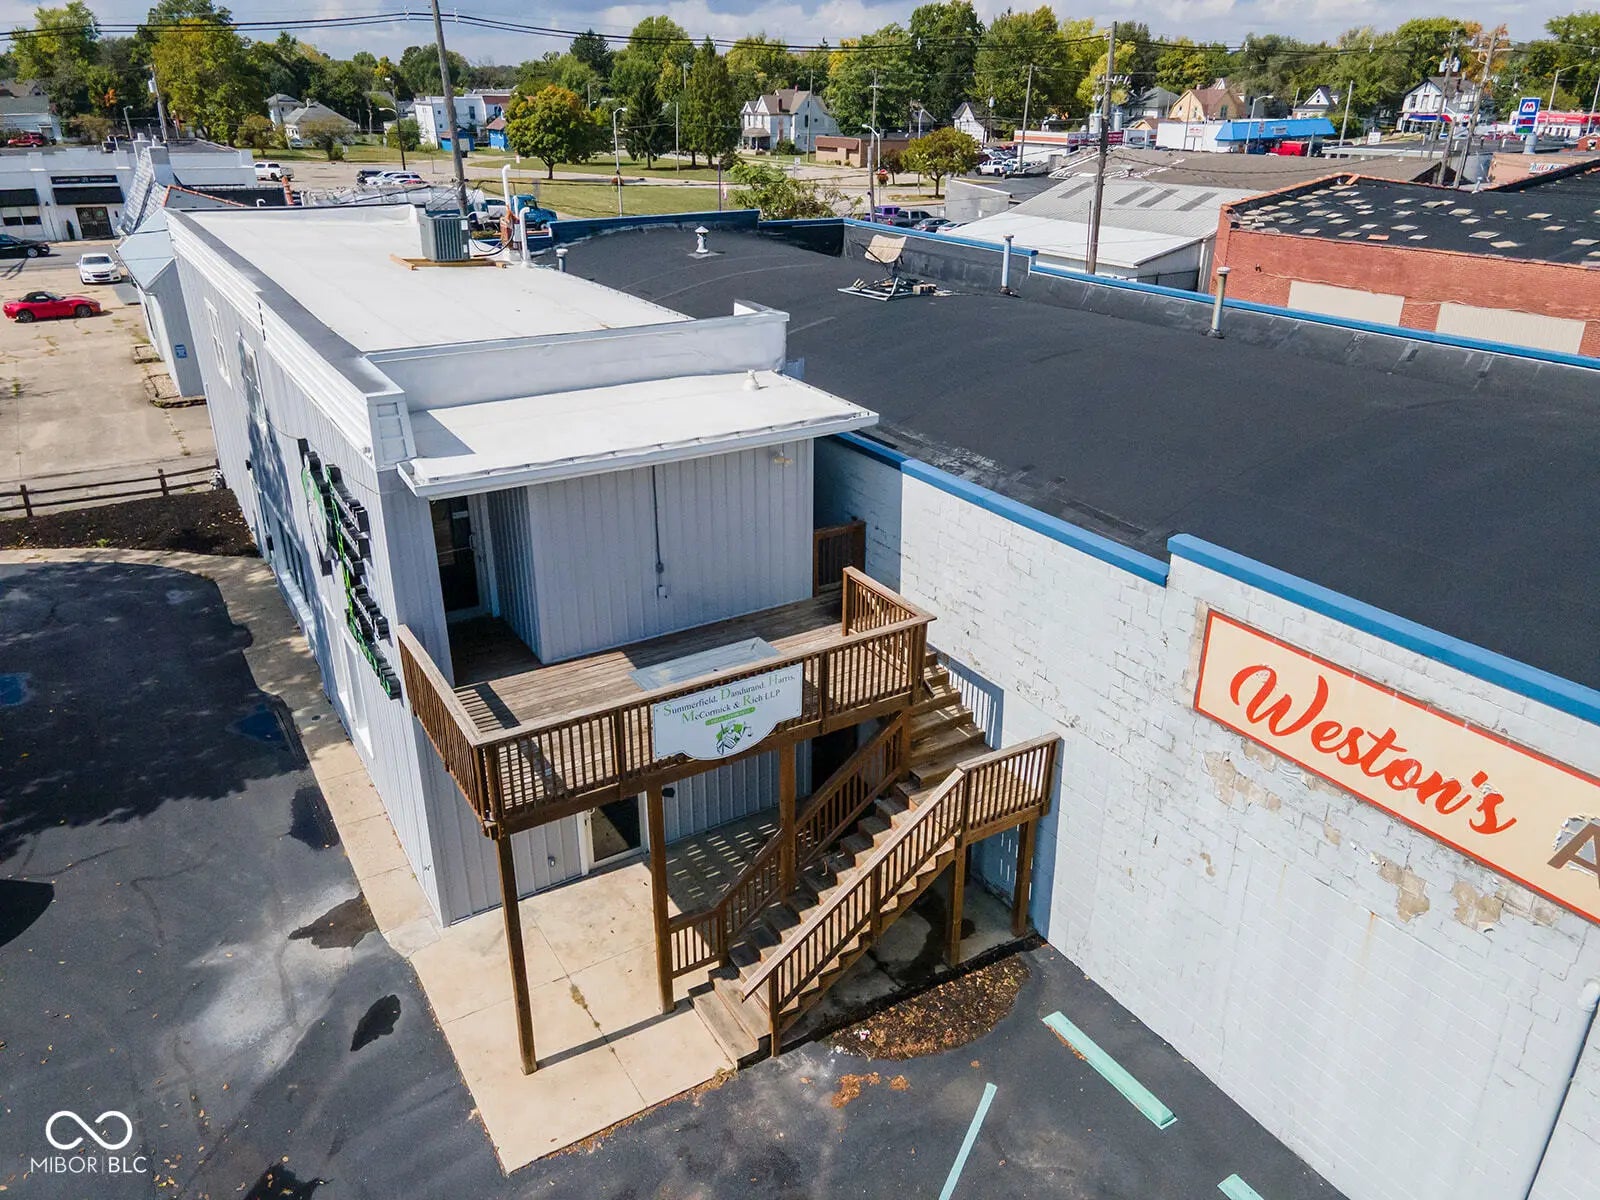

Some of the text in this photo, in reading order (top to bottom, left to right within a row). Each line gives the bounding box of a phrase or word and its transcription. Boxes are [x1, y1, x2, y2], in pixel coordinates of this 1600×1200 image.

[681, 704, 731, 724] McCormick
[733, 701, 741, 709] &
[742, 692, 764, 707] Rich
[764, 689, 781, 701] LLP
[1228, 663, 1517, 835] Weston's
